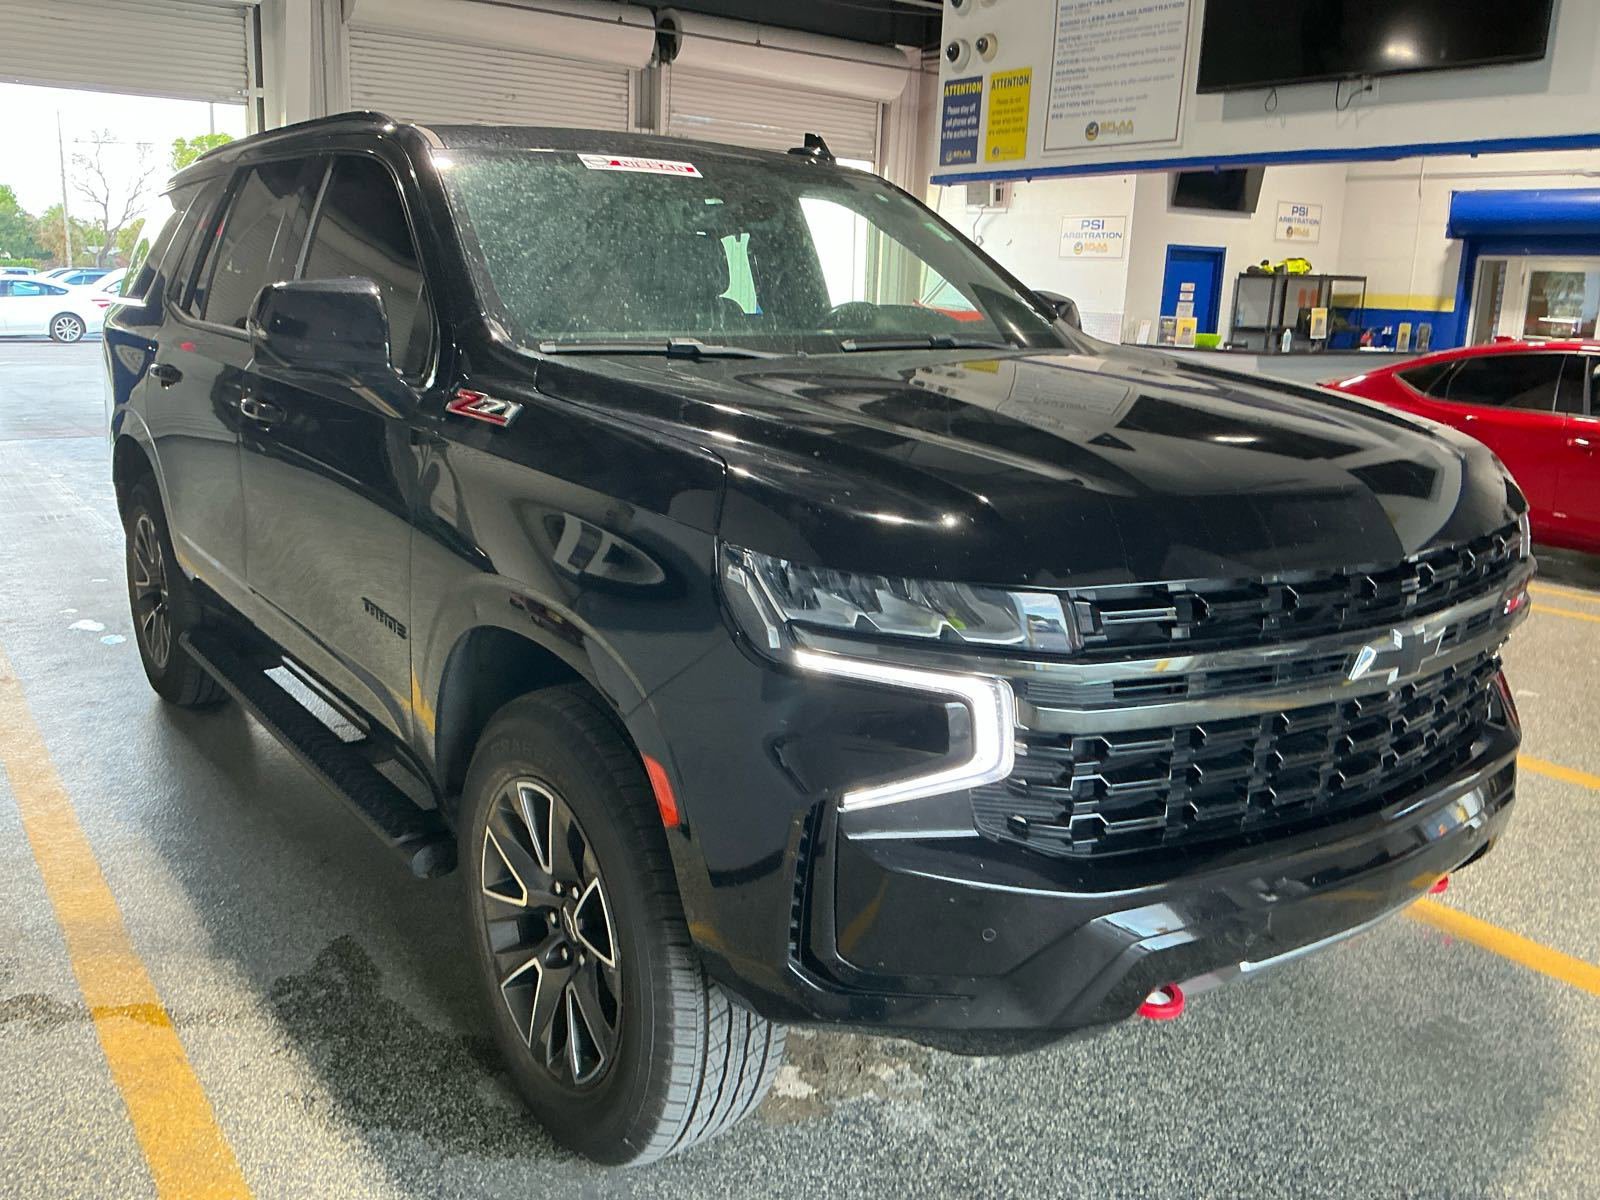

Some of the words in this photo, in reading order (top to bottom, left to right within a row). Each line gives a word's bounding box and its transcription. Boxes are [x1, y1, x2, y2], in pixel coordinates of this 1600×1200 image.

[992, 75, 1029, 90] ATTENTION
[944, 82, 981, 96] ATTENTION
[1291, 205, 1308, 217] PSI
[1080, 219, 1105, 231] PSI
[1279, 216, 1319, 225] ARBITRATION
[1063, 231, 1123, 240] ARBITRATION
[445, 388, 523, 427] Z71
